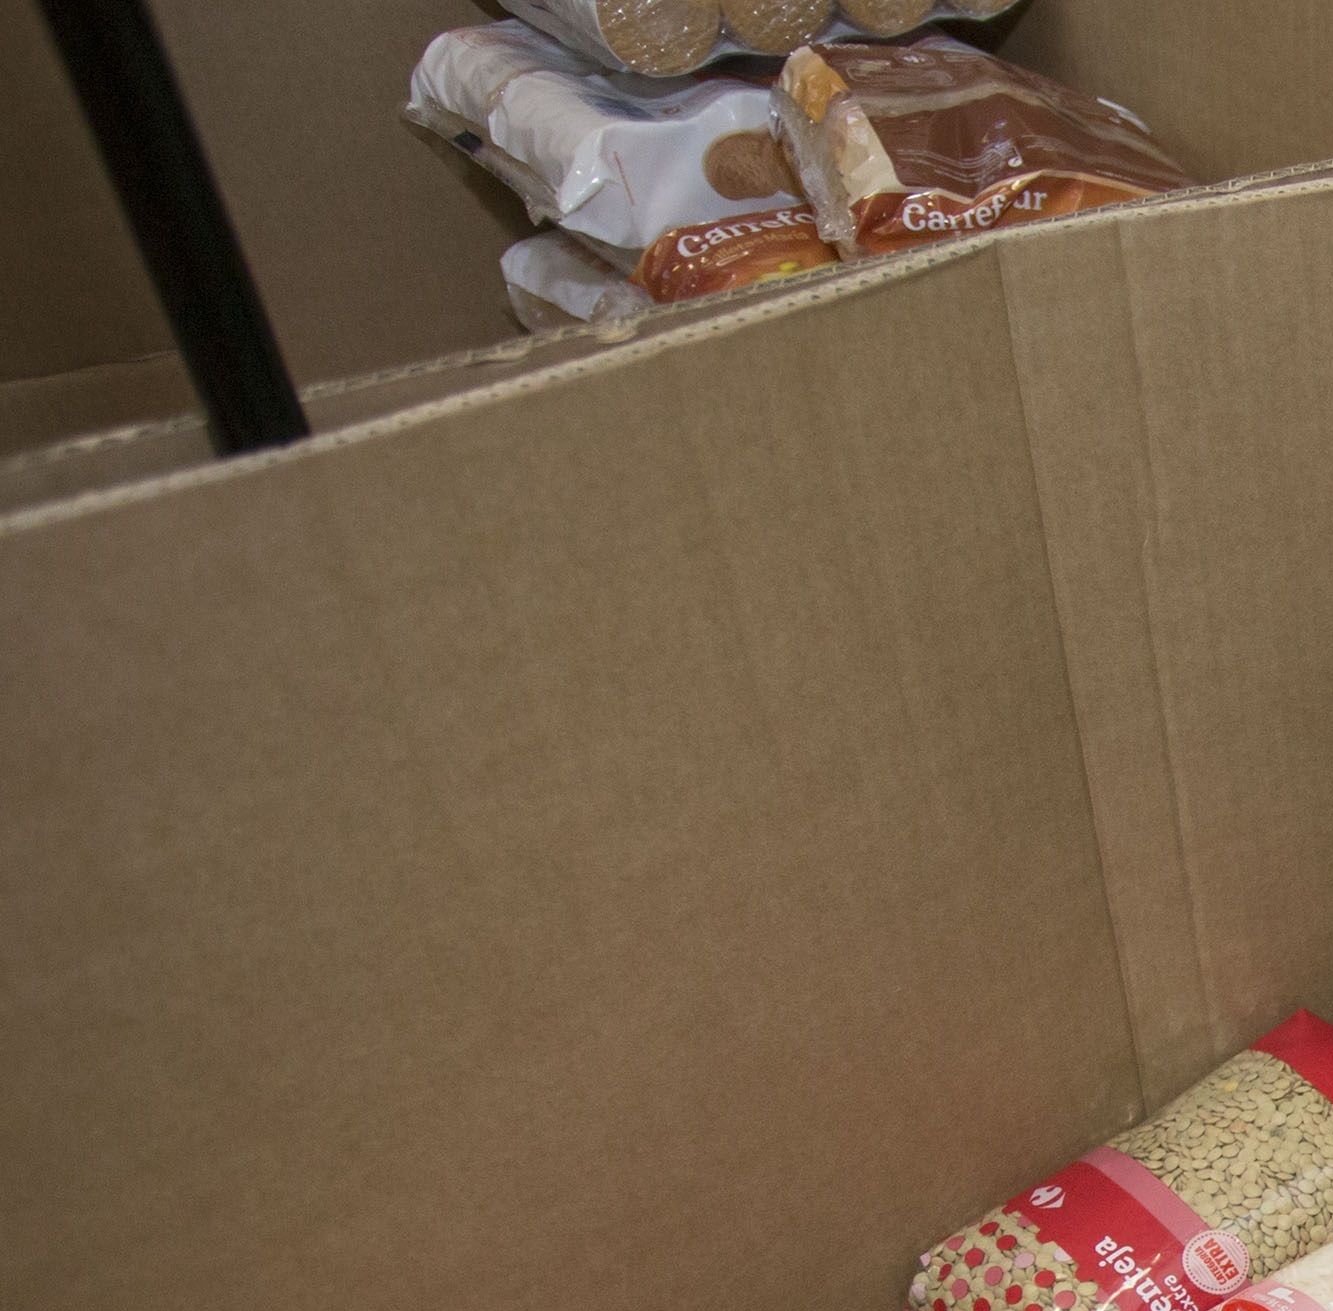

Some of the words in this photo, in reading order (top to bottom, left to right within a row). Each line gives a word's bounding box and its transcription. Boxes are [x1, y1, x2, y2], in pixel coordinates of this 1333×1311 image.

[901, 188, 1048, 233] Carrefur
[676, 208, 815, 259] Carrefo
[1202, 1237, 1239, 1280] EXTRA
